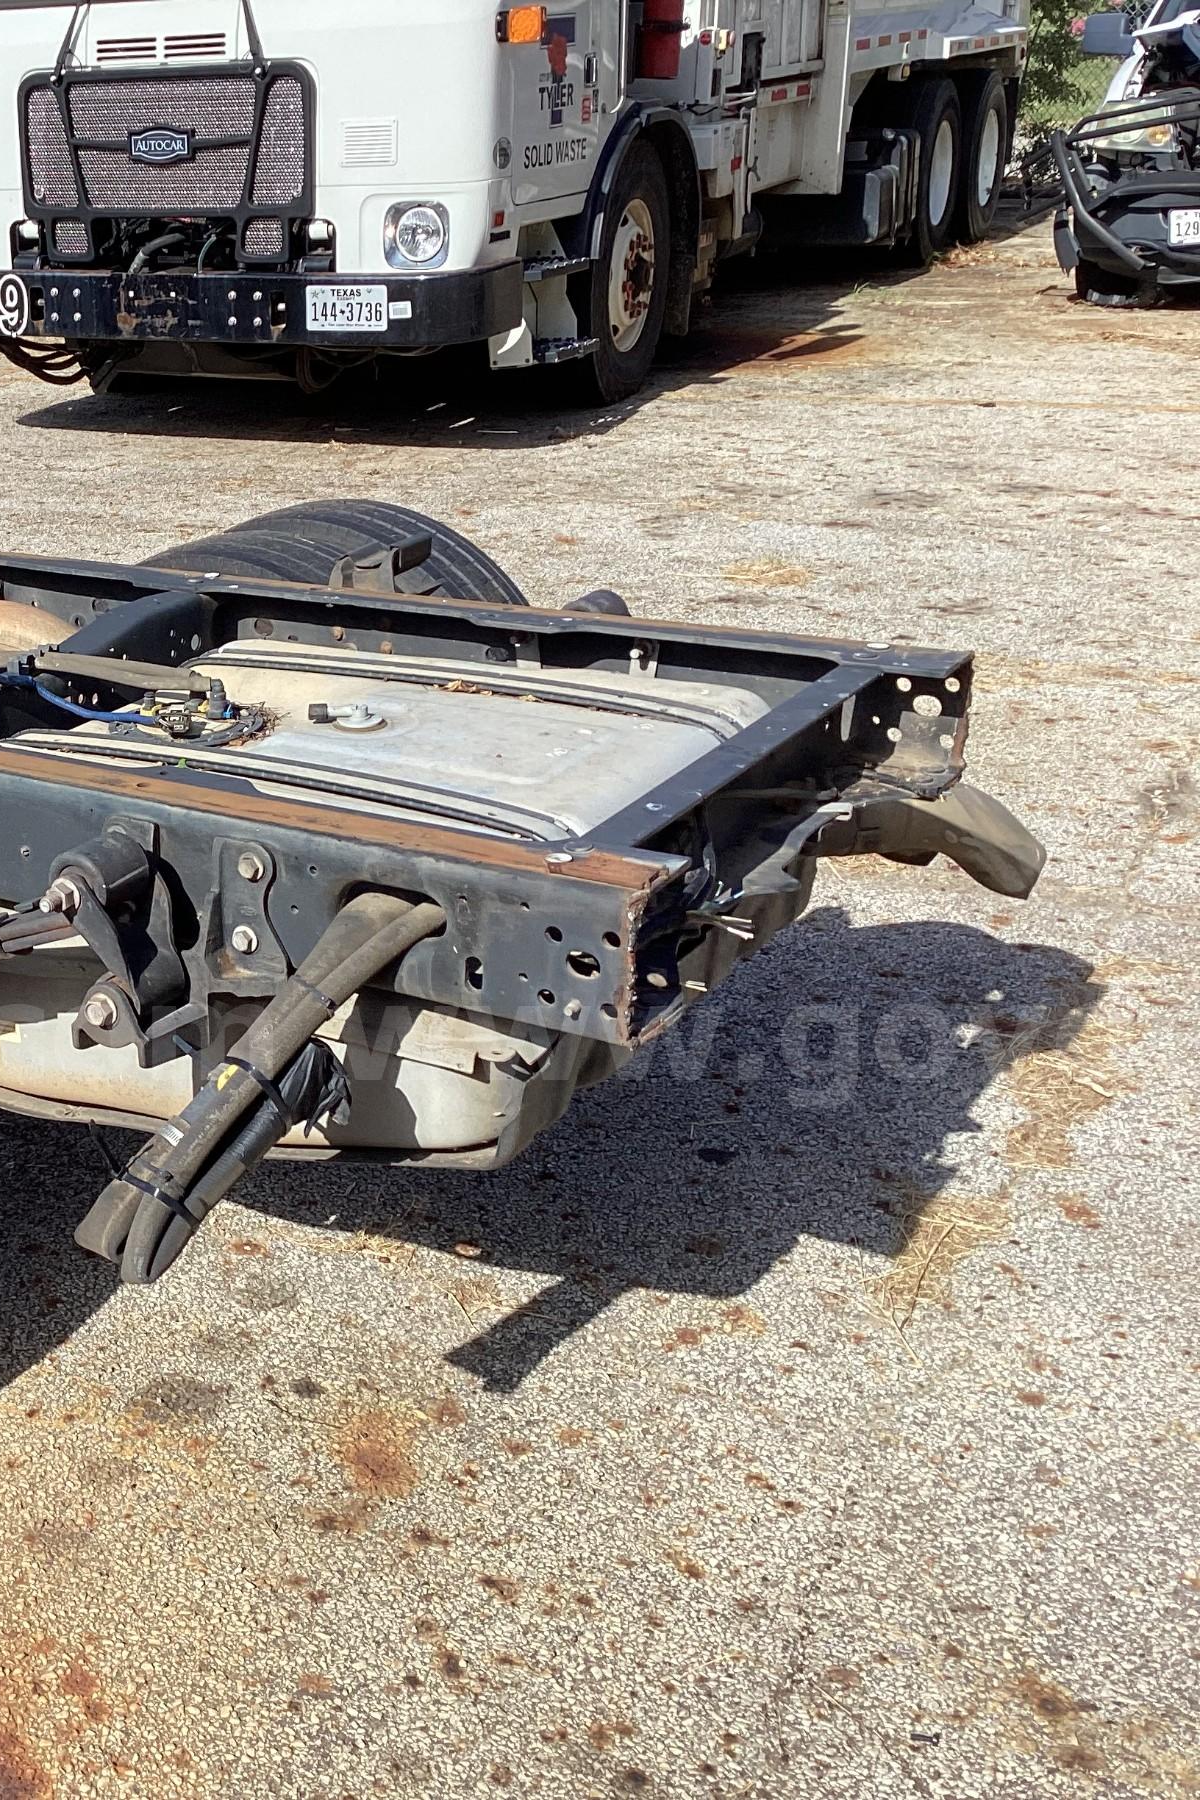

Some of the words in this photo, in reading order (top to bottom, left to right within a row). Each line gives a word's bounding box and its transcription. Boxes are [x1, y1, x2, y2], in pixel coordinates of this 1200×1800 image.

[539, 83, 574, 110] TYLER
[135, 140, 184, 151] AUTOCAR
[523, 143, 553, 169] SOLID
[555, 138, 587, 164] WASTE
[330, 288, 362, 297] TEXAS
